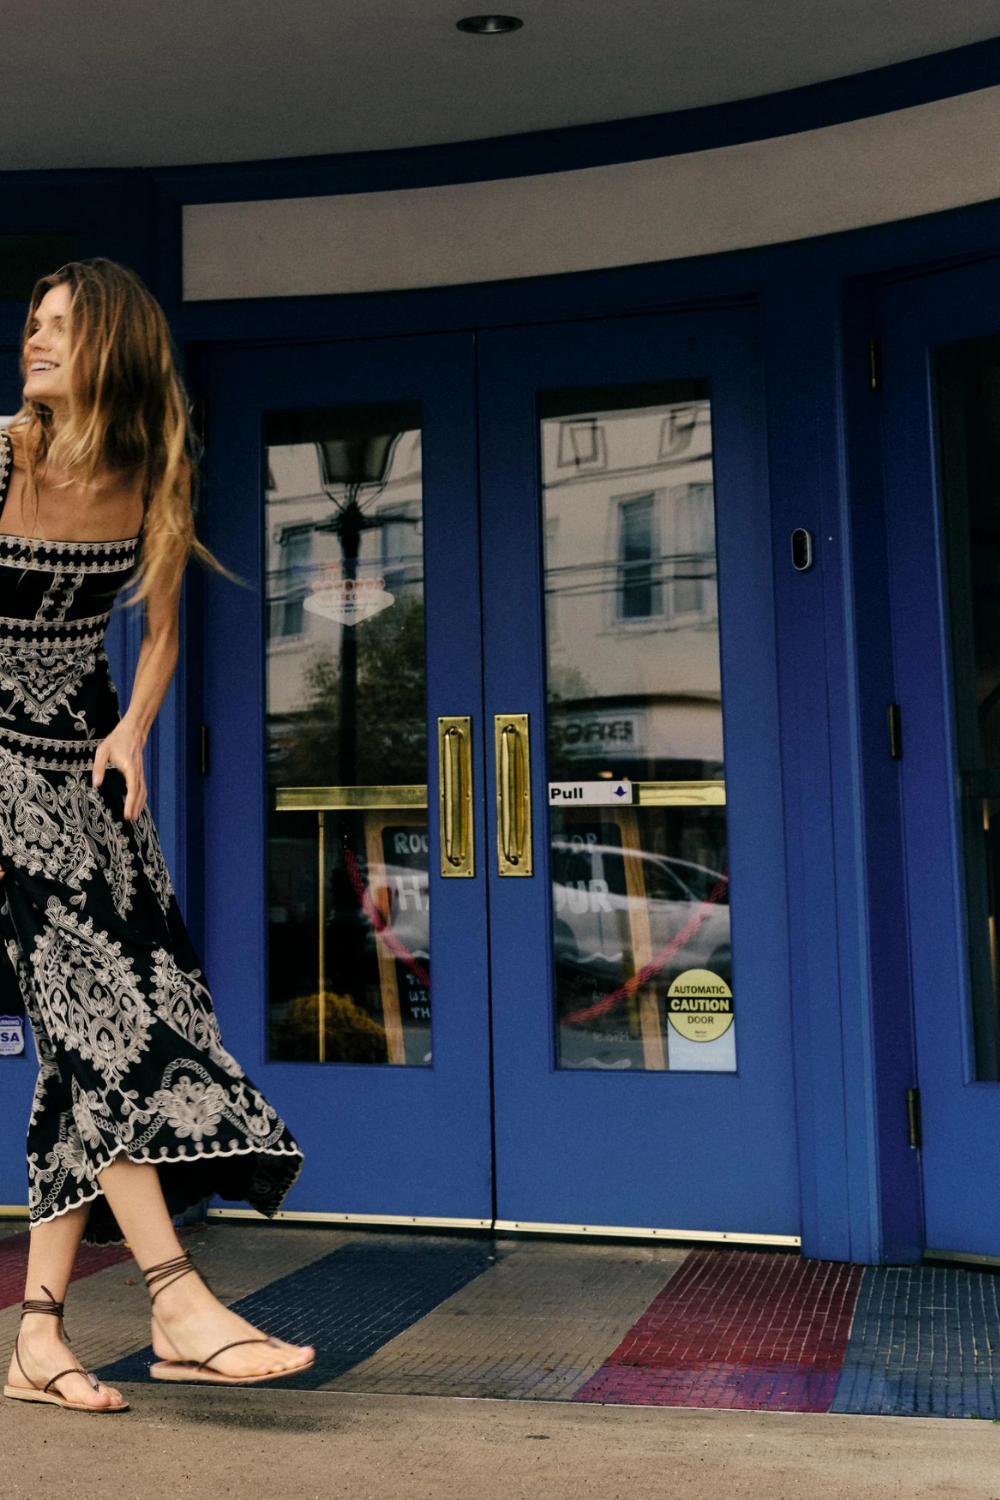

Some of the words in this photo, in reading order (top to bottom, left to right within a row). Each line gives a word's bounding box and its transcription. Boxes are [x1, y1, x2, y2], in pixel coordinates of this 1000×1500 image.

[551, 787, 583, 799] Pull
[673, 985, 725, 995] AUTOMATIC
[670, 998, 730, 1012] CAUTION
[687, 1015, 714, 1025] DOOR
